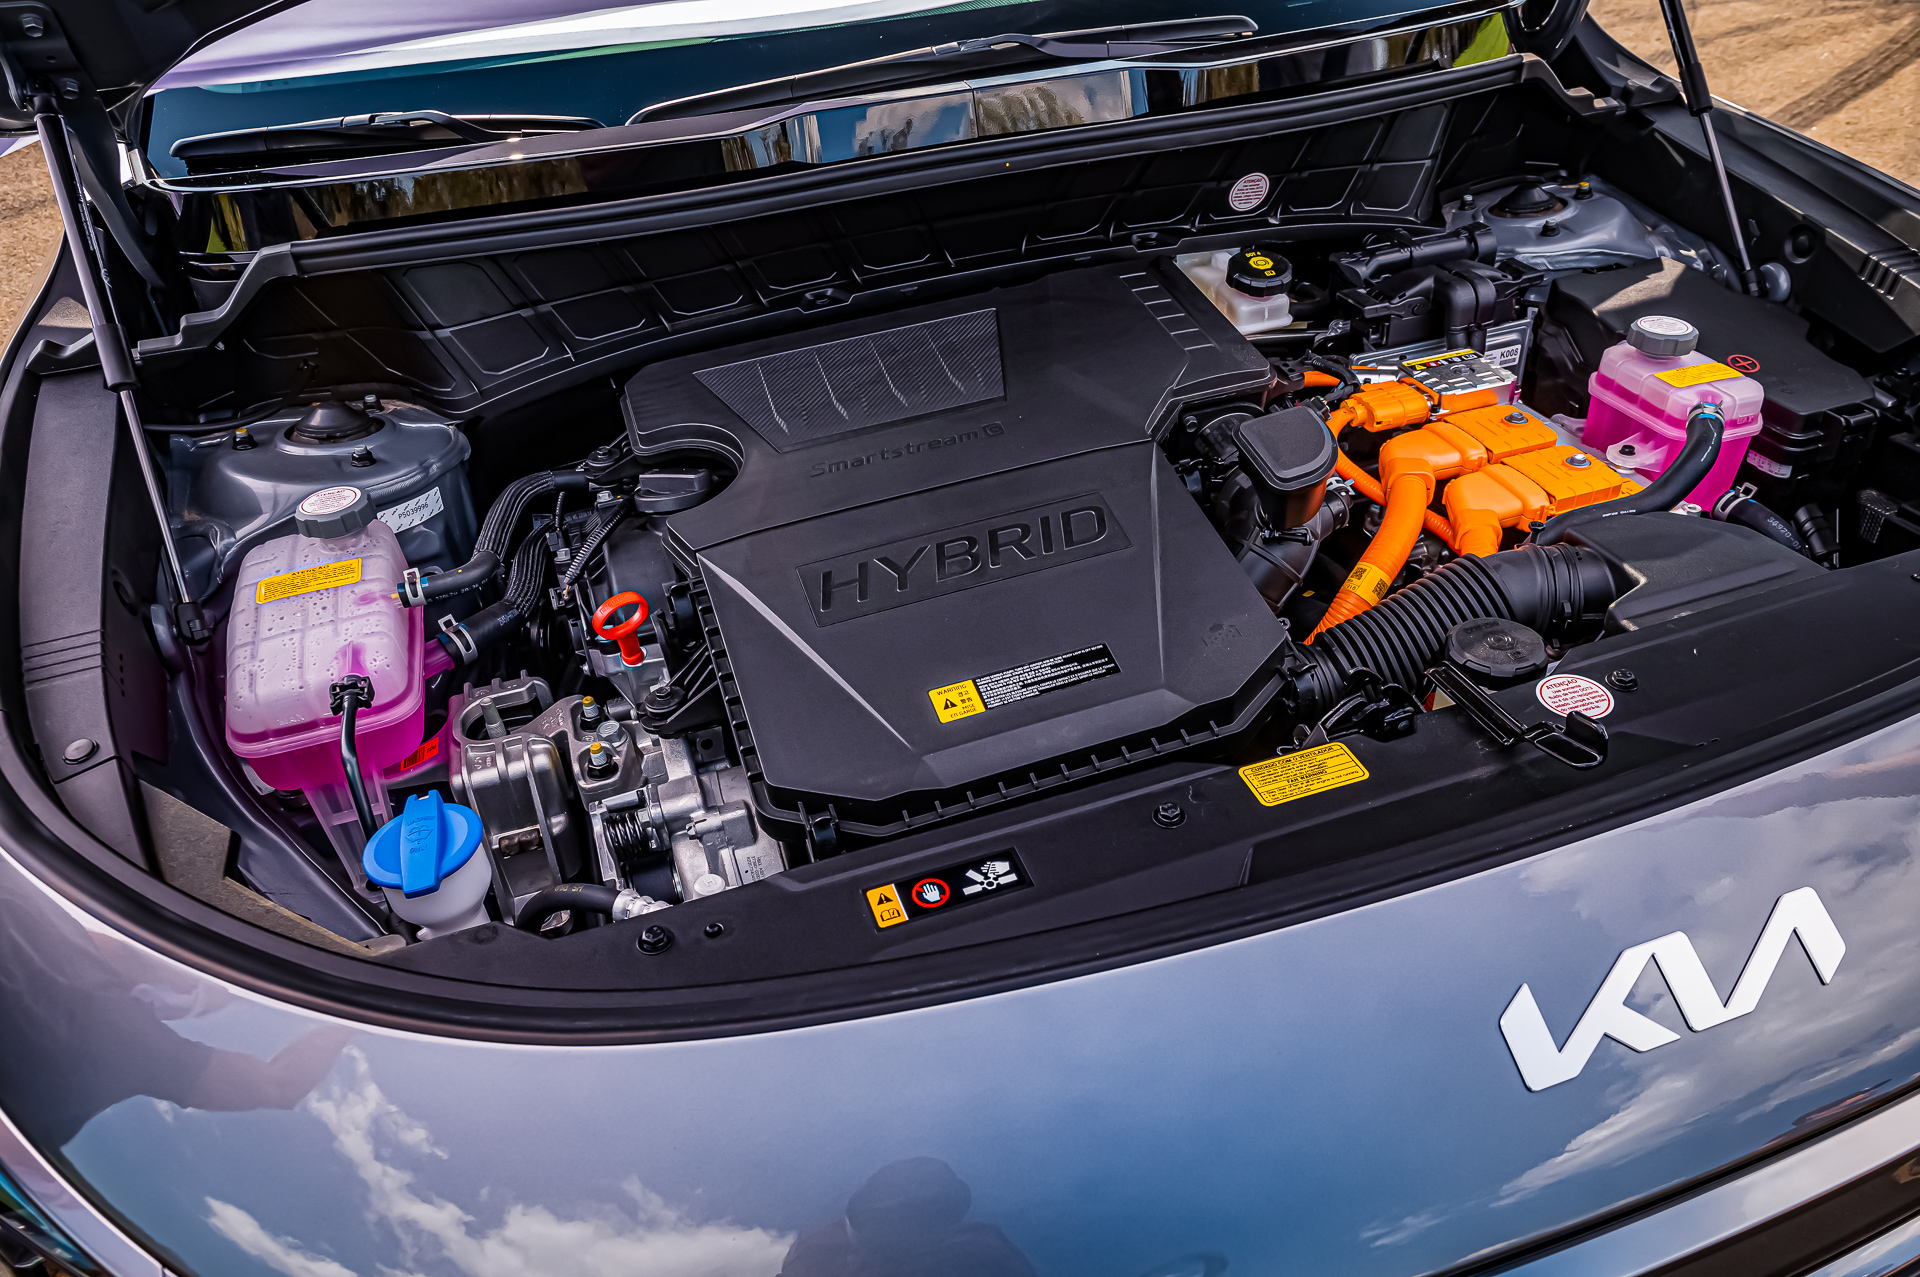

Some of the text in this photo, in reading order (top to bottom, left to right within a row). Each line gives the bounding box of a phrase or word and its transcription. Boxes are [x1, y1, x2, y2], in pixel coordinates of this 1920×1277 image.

[811, 430, 979, 477] Smartstream
[820, 505, 1108, 612] HYBRID
[937, 684, 967, 696] WARNING
[1546, 679, 1577, 690] ATENÇÃO
[960, 707, 977, 716] GARDE
[1250, 762, 1277, 772] CUIDADO
[1298, 746, 1333, 758] VENTILADOR
[1299, 769, 1327, 780] WARNING
[1500, 887, 1846, 1092] KIA
